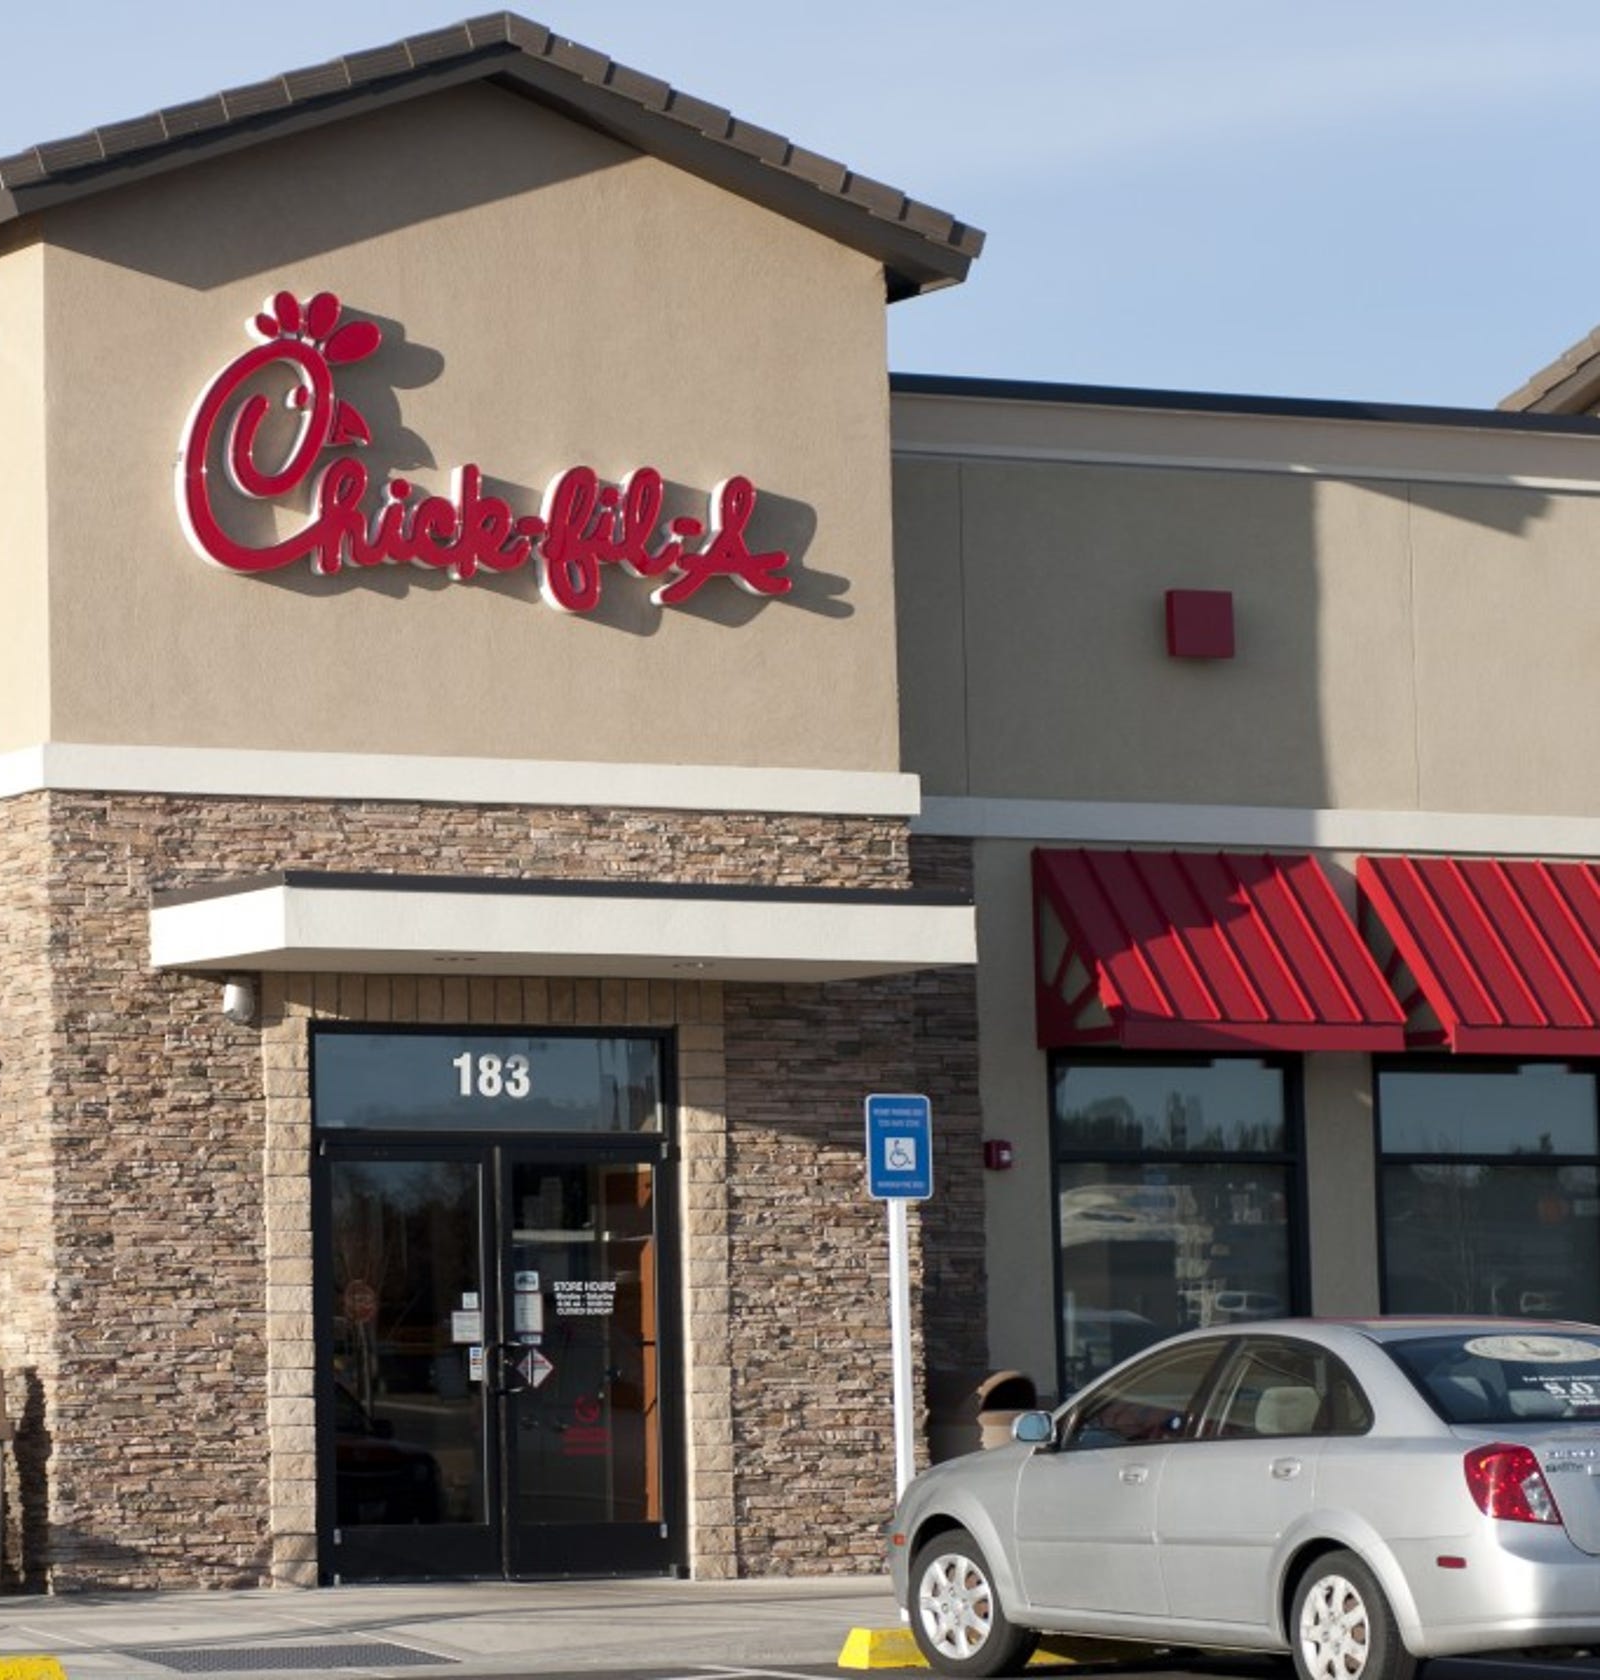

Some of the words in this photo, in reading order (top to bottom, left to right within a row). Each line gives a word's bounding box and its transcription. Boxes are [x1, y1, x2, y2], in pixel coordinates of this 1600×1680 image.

[176, 290, 792, 612] Chick-fil-A
[453, 1052, 530, 1098] 183
[554, 1281, 583, 1292] STORE
[584, 1281, 616, 1292] HOURS
